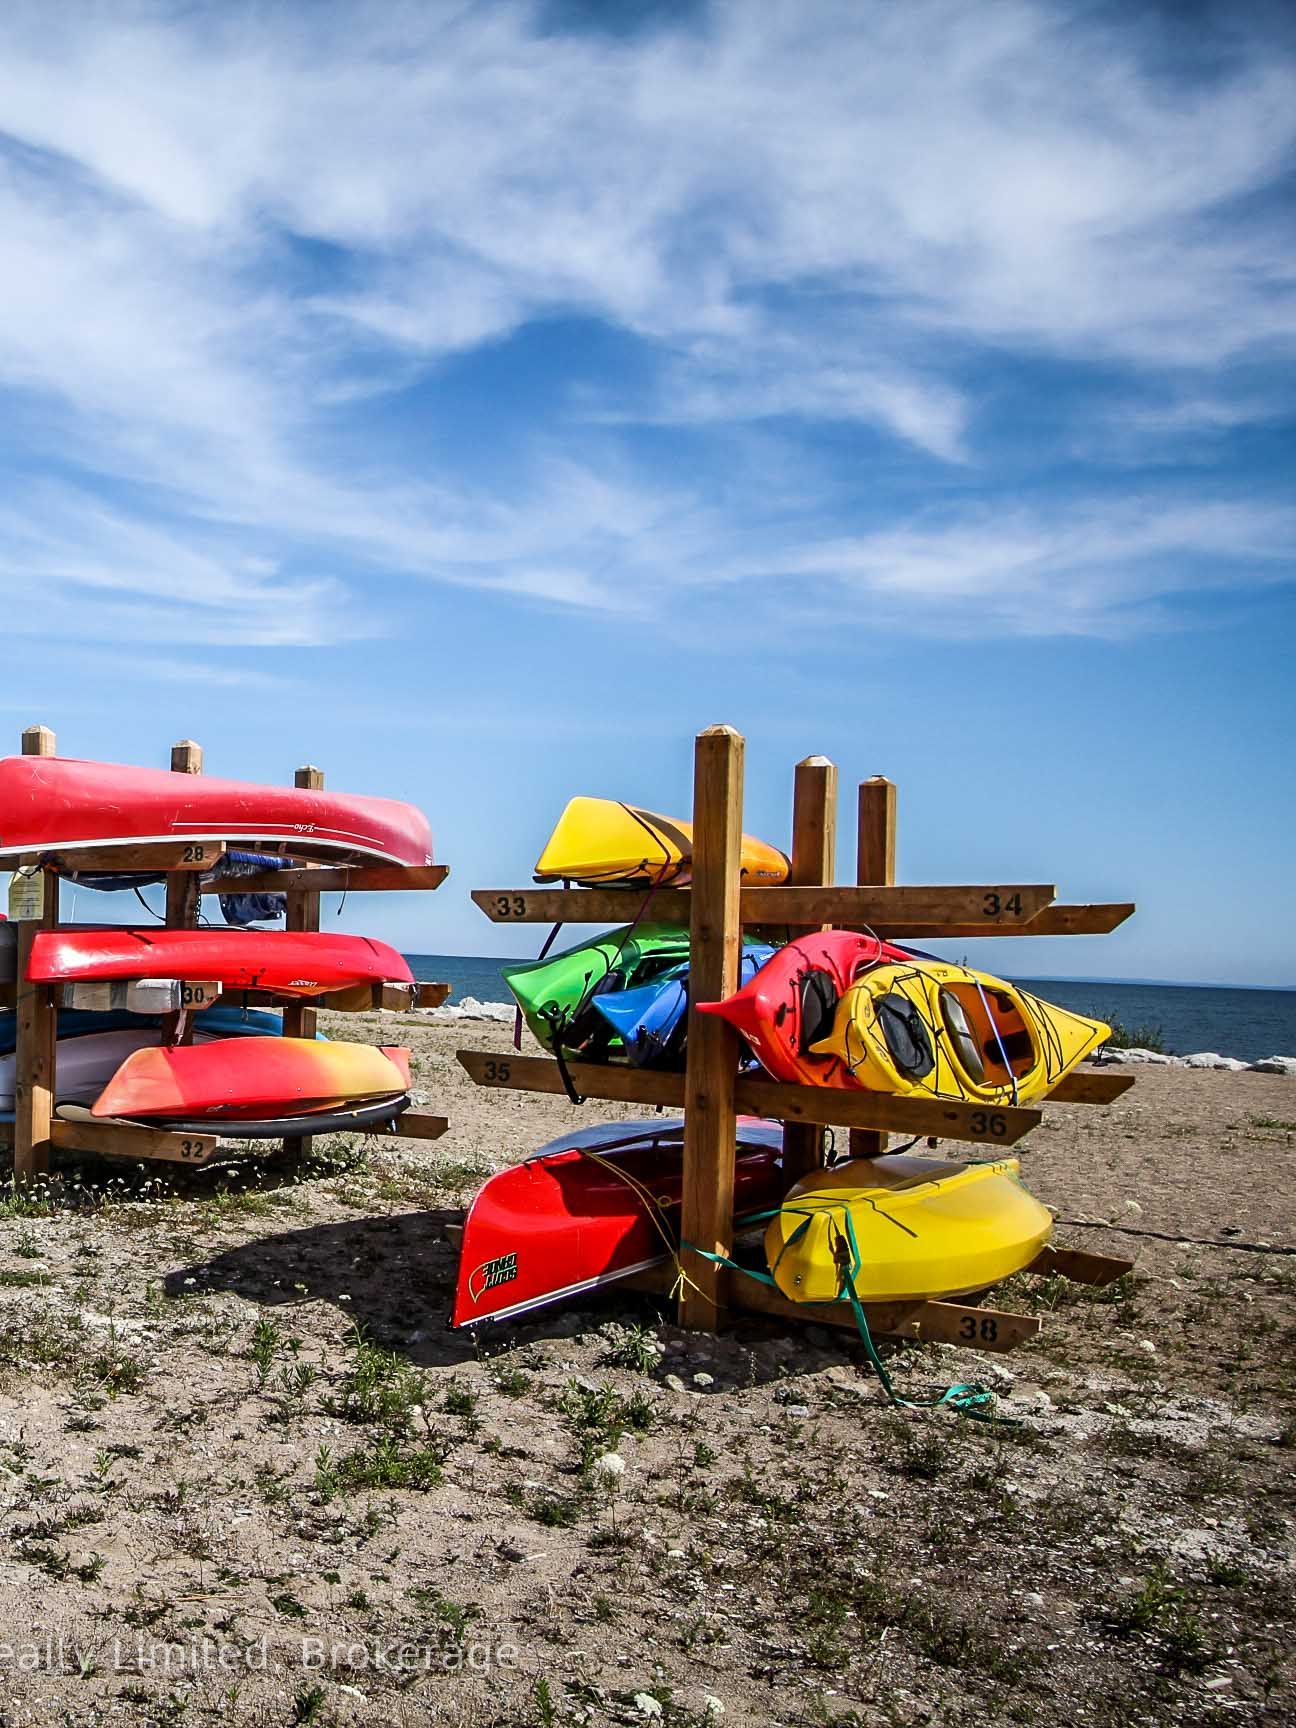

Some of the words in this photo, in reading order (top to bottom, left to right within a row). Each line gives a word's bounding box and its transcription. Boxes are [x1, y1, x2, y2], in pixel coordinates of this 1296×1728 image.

[184, 846, 204, 862] 28
[497, 896, 526, 916] 33
[983, 893, 1023, 916] 34
[183, 987, 204, 1004] 30
[484, 1061, 511, 1081] 35
[969, 1111, 1007, 1137] 36
[181, 1140, 204, 1158] 32
[959, 1316, 998, 1342] 38
